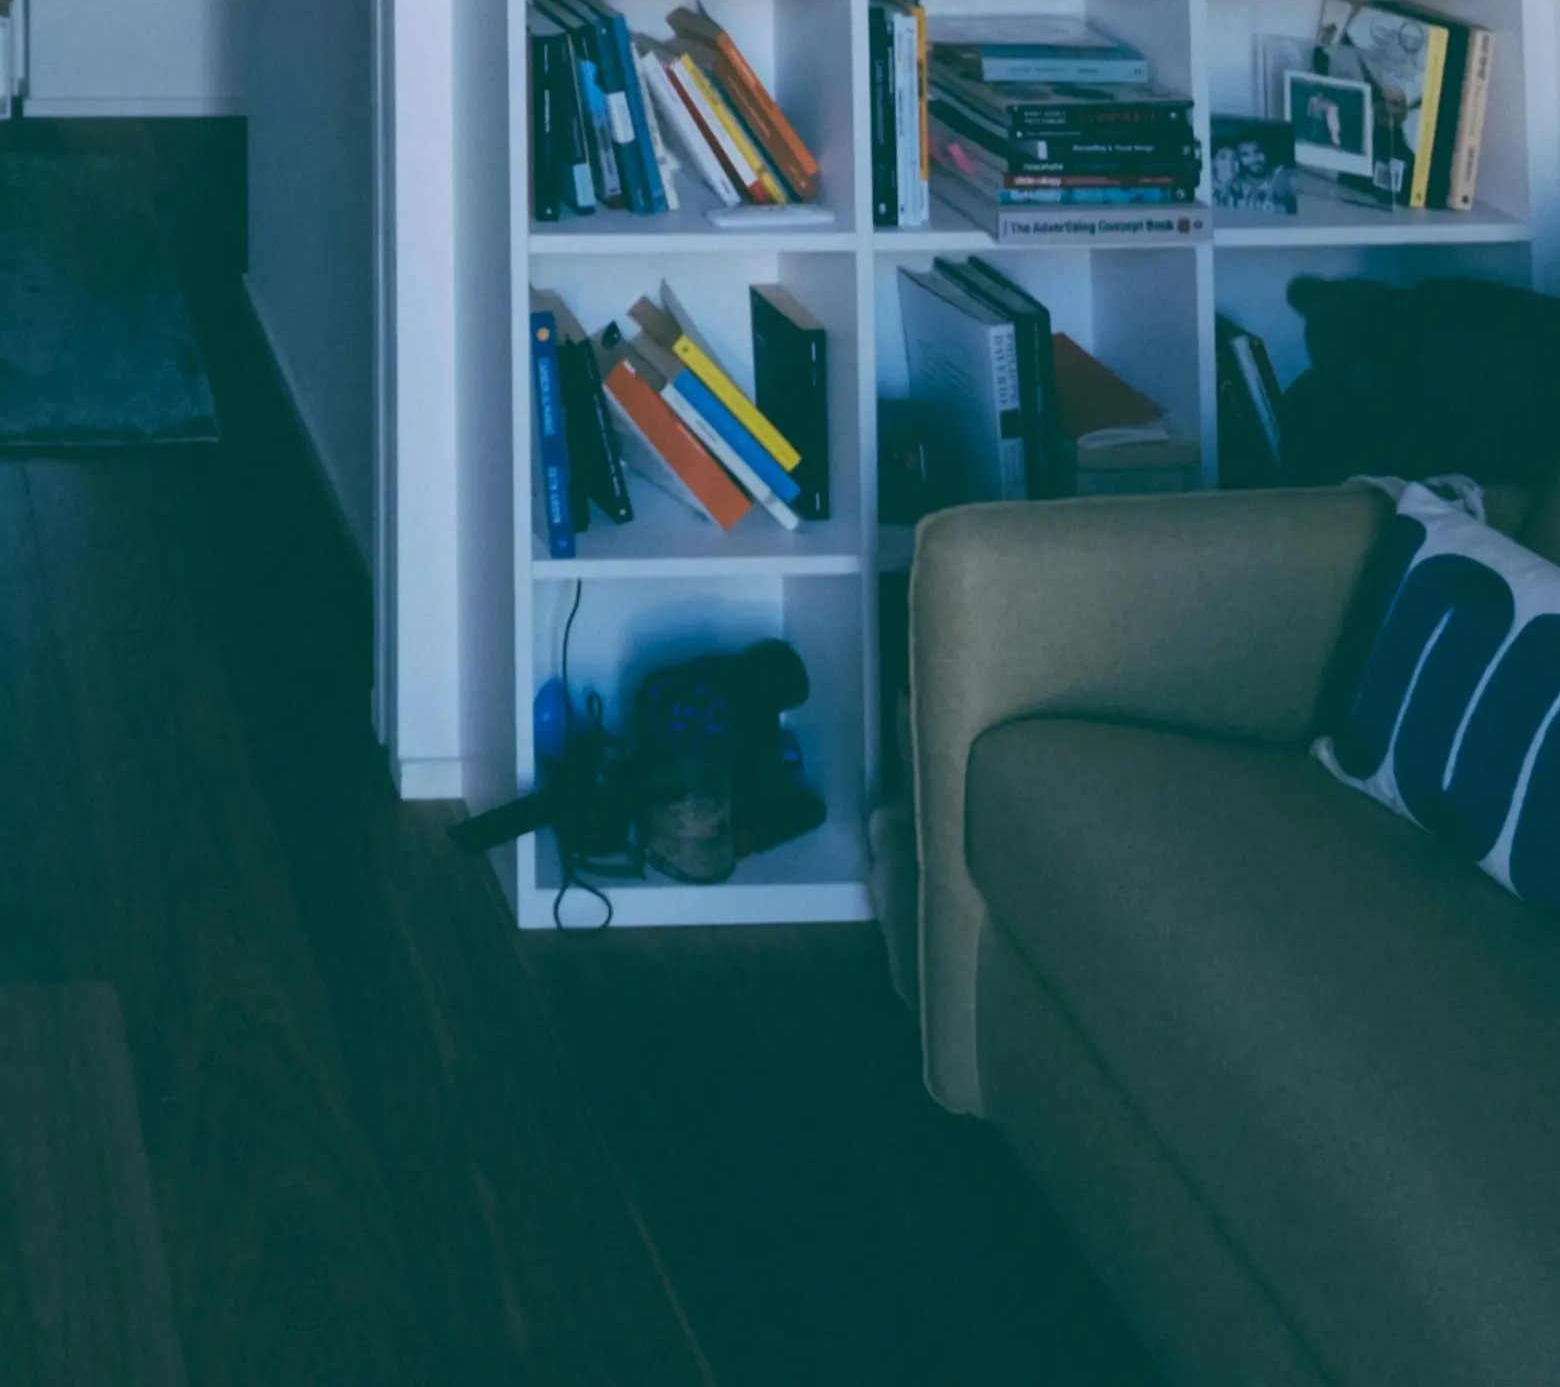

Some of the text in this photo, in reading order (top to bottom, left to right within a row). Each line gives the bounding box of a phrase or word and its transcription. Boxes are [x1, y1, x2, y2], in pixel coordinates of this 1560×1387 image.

[1010, 219, 1174, 236] The Advertising Concept Book
